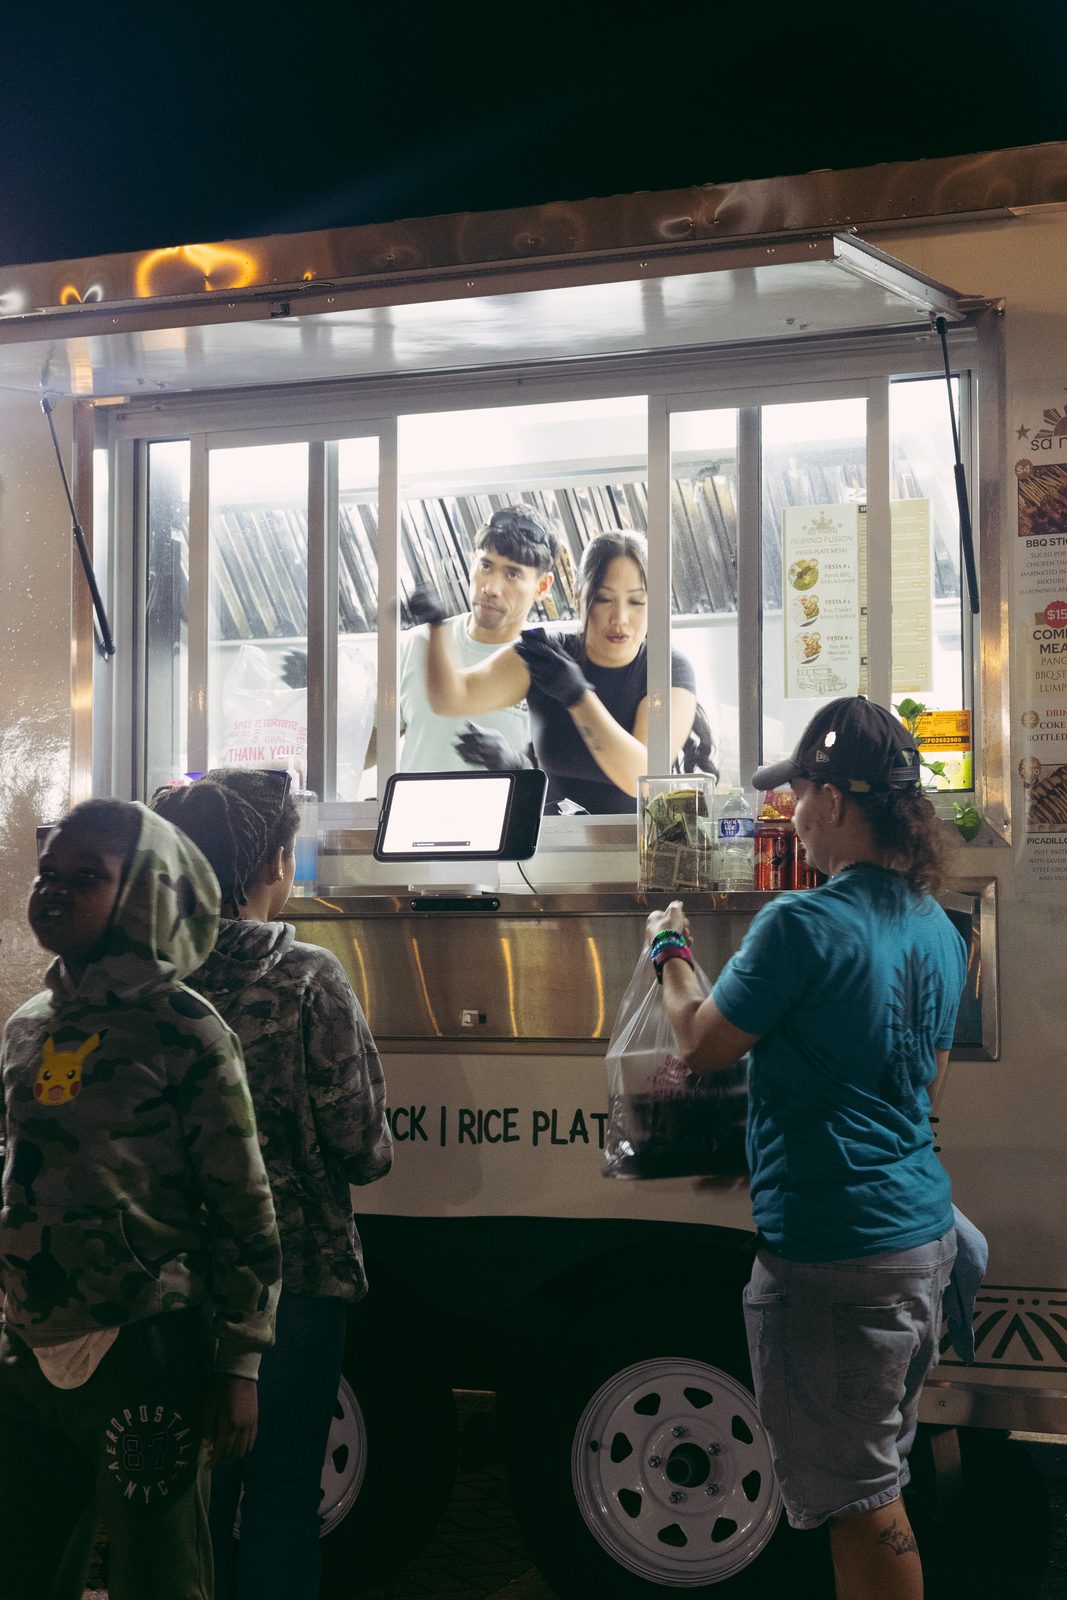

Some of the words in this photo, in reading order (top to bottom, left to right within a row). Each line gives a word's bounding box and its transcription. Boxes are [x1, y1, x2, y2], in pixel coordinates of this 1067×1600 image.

[1031, 438, 1052, 450] sa
[823, 535, 853, 543] FUSION
[1026, 539, 1048, 548] BBQ
[1033, 628, 1067, 640] COM
[1040, 721, 1066, 729] COKE
[228, 745, 265, 762] THANK
[269, 745, 294, 759] YOU
[458, 1106, 520, 1145] RICE
[105, 1405, 194, 1470] AEROPOSTALE
[123, 1480, 169, 1504] NYC
